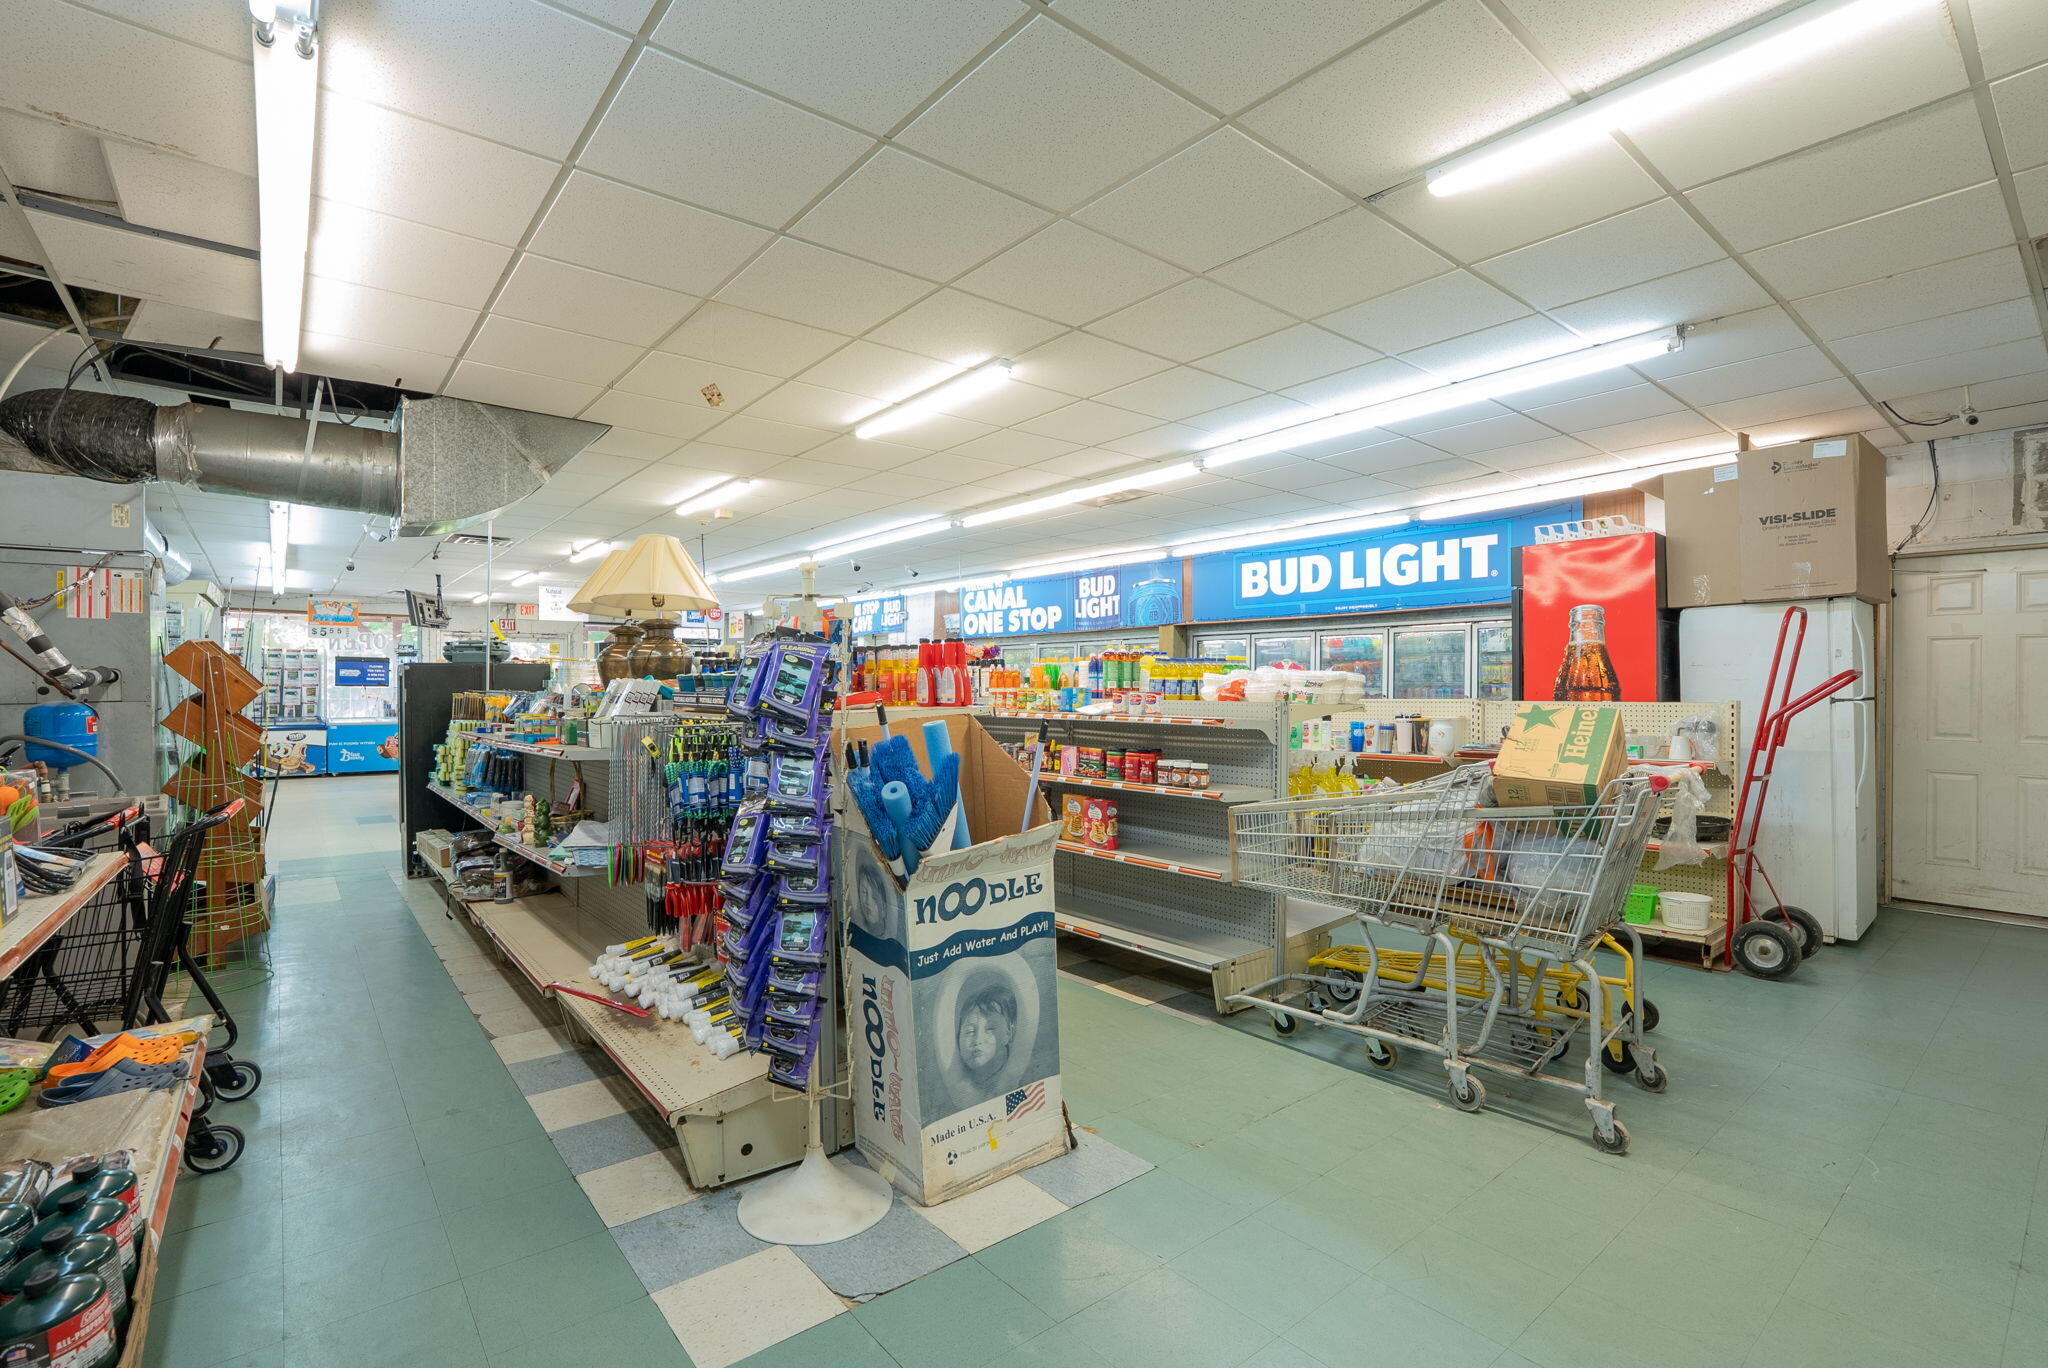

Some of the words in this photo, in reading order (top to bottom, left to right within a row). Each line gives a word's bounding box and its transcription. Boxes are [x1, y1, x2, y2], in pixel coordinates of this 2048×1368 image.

[1759, 508, 1836, 525] VISI-SLIDE
[1241, 554, 1332, 599] BUD
[1340, 534, 1499, 591] LIGHT
[963, 586, 1028, 613] CANAL
[1078, 574, 1116, 599] BUD
[520, 605, 536, 615] EXIT
[1074, 595, 1120, 619] LIGHT
[500, 620, 516, 630] EXIT
[963, 611, 1004, 635] ONE
[1008, 606, 1062, 633] STOP
[780, 644, 817, 655] CLEANING
[1564, 708, 1598, 759] Heine
[917, 952, 939, 967] Just
[943, 943, 962, 959] Add
[965, 937, 996, 952] Water
[1000, 929, 1018, 942] And
[1020, 920, 1049, 937] PLAY!!
[930, 1129, 955, 1147] Made
[957, 1123, 966, 1134] in
[968, 1112, 997, 1129] U.S.A.
